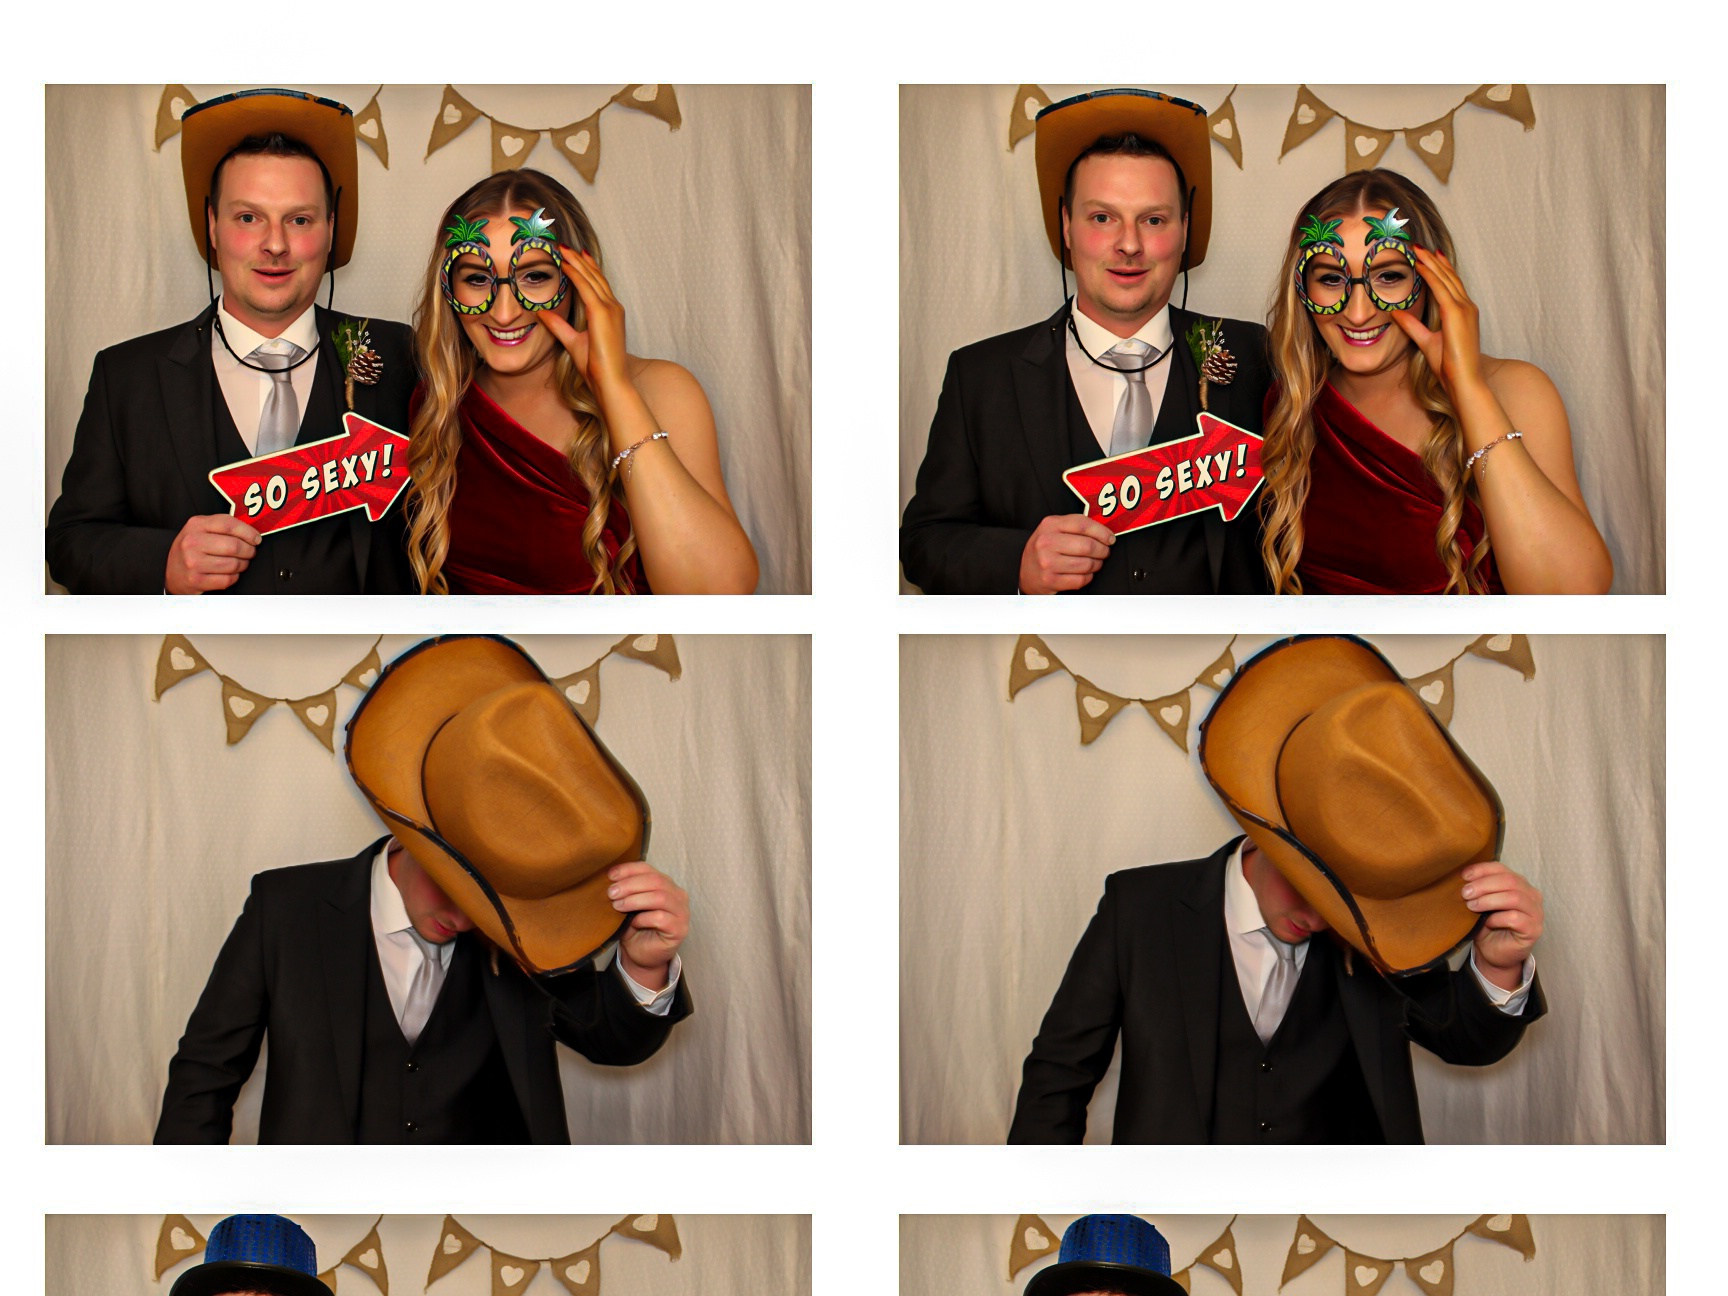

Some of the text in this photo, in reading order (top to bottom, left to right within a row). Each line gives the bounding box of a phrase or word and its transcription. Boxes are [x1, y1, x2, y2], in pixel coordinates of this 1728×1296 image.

[243, 443, 395, 517] SO SEXY!
[1098, 443, 1250, 517] SO SEXY!
